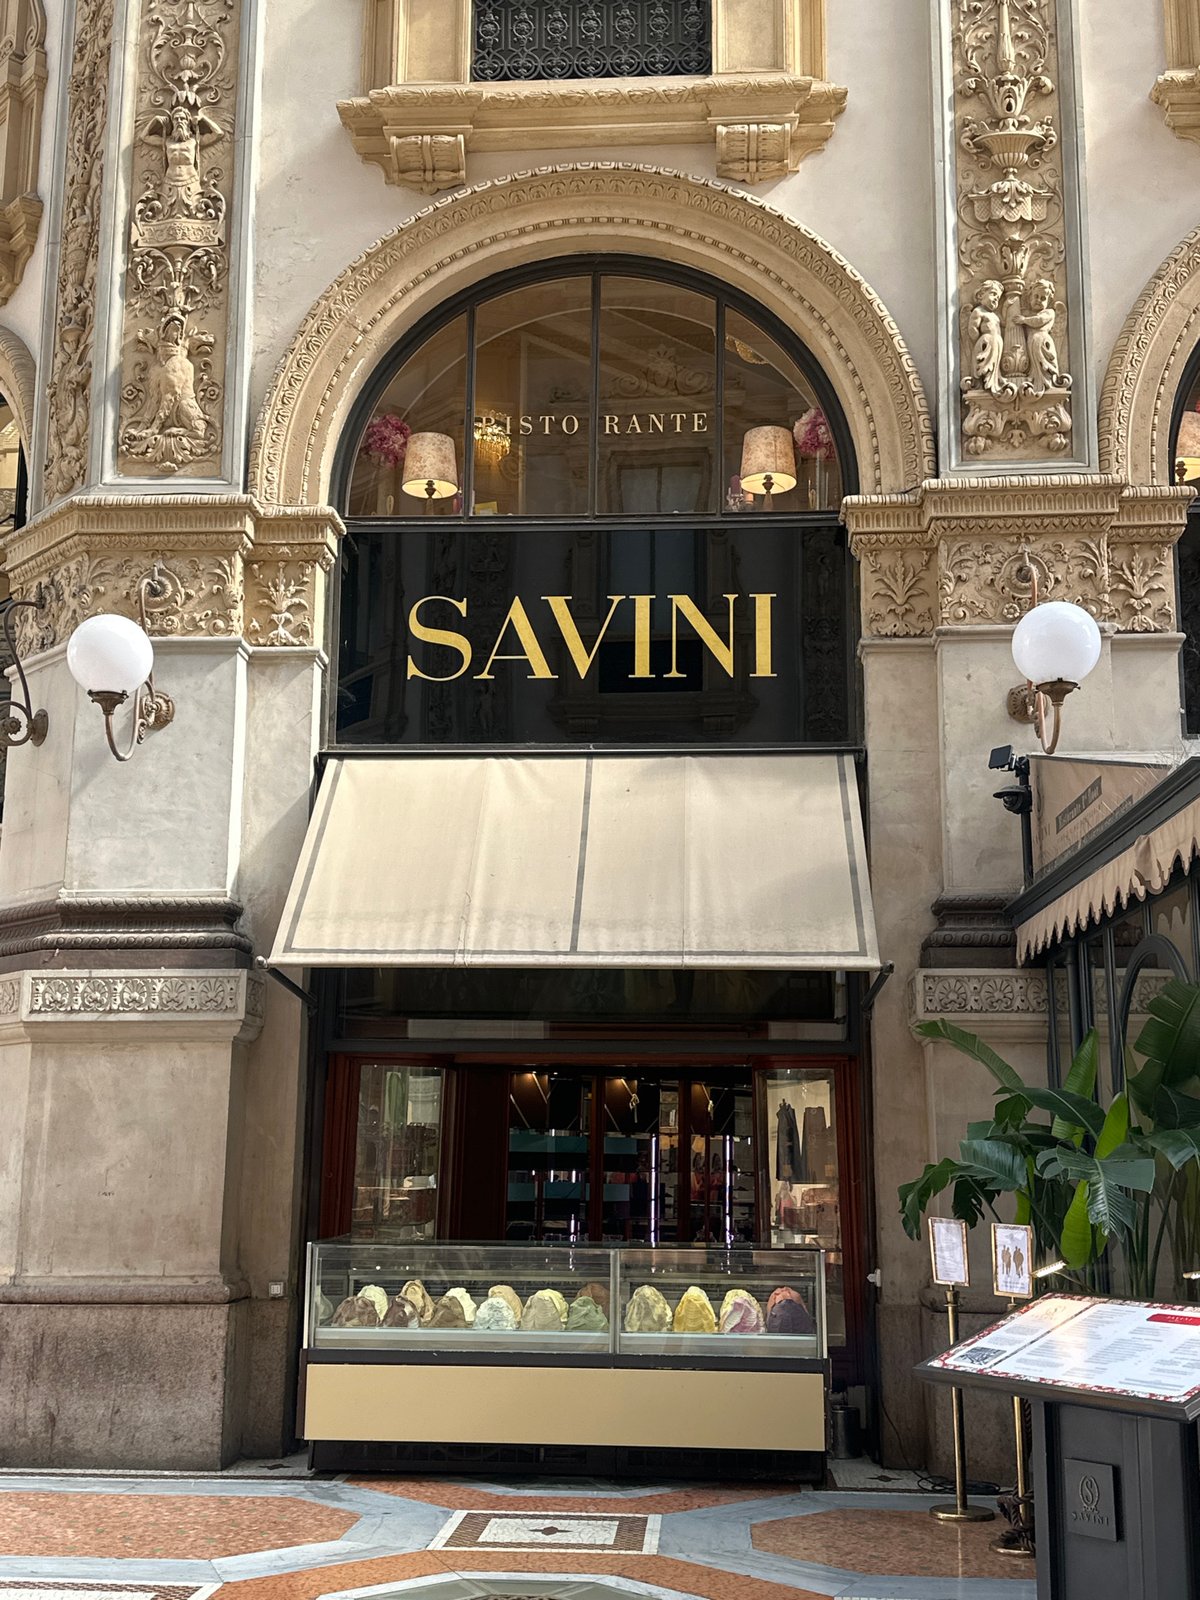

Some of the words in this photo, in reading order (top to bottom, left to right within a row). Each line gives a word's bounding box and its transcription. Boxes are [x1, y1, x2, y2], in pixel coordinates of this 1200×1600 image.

[481, 414, 579, 436] RISTO
[604, 412, 708, 435] RANTE
[406, 593, 777, 682] SAVINI
